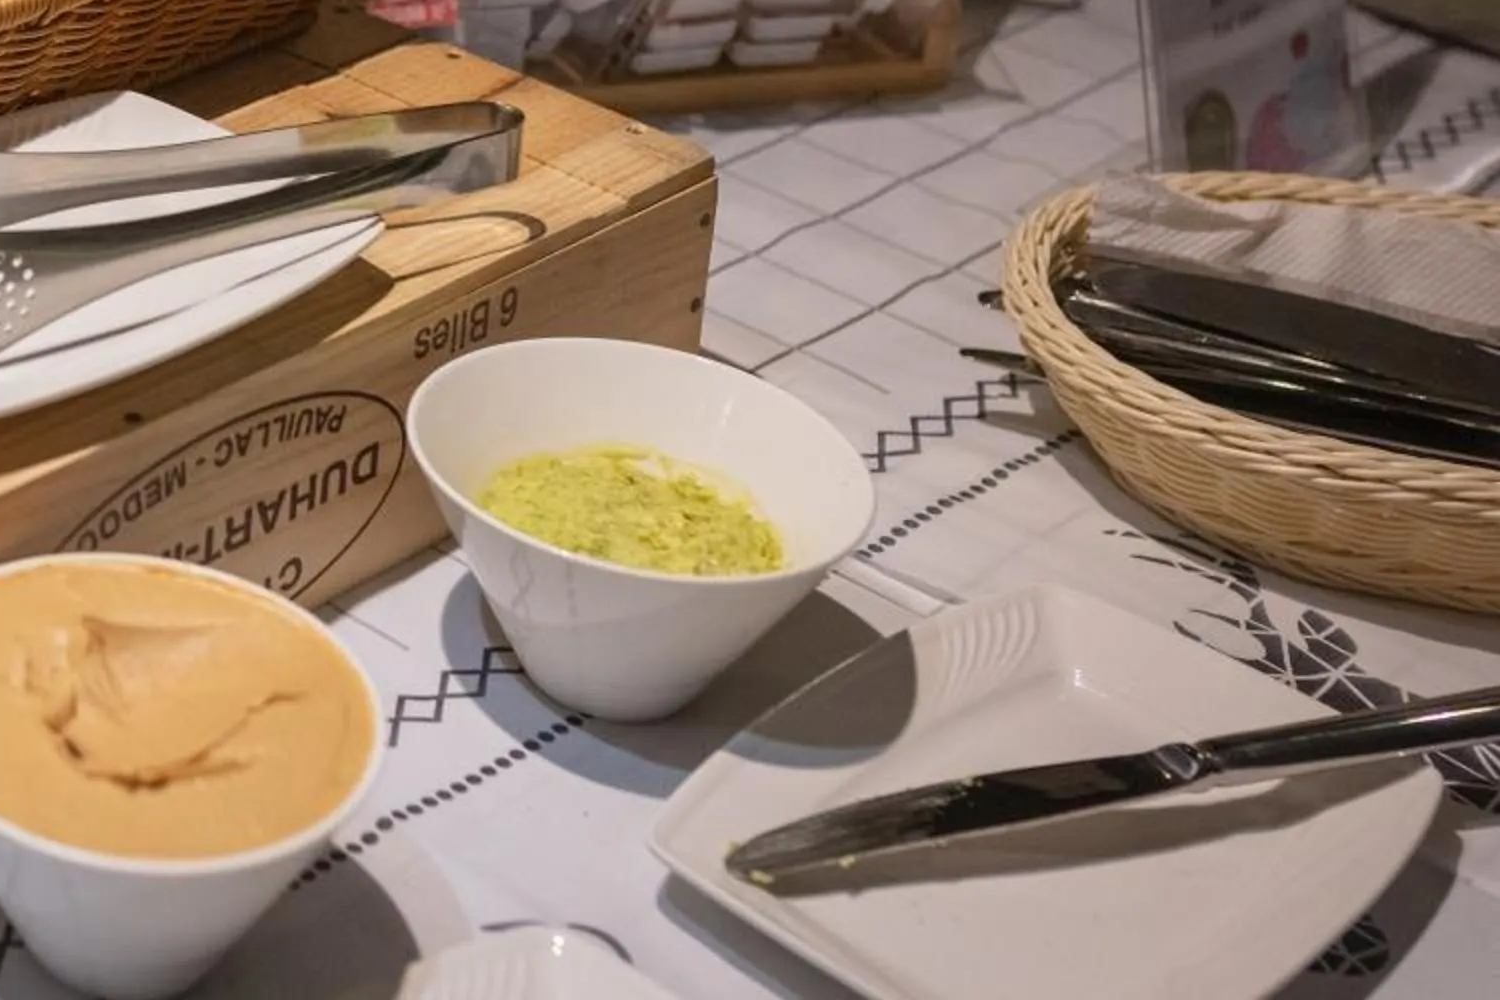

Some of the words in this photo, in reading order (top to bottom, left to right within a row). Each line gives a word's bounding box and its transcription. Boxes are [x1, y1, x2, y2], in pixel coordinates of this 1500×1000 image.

[500, 286, 518, 328] 6
[214, 404, 347, 468] PAUILLAC
[160, 441, 380, 566] DUHART-
